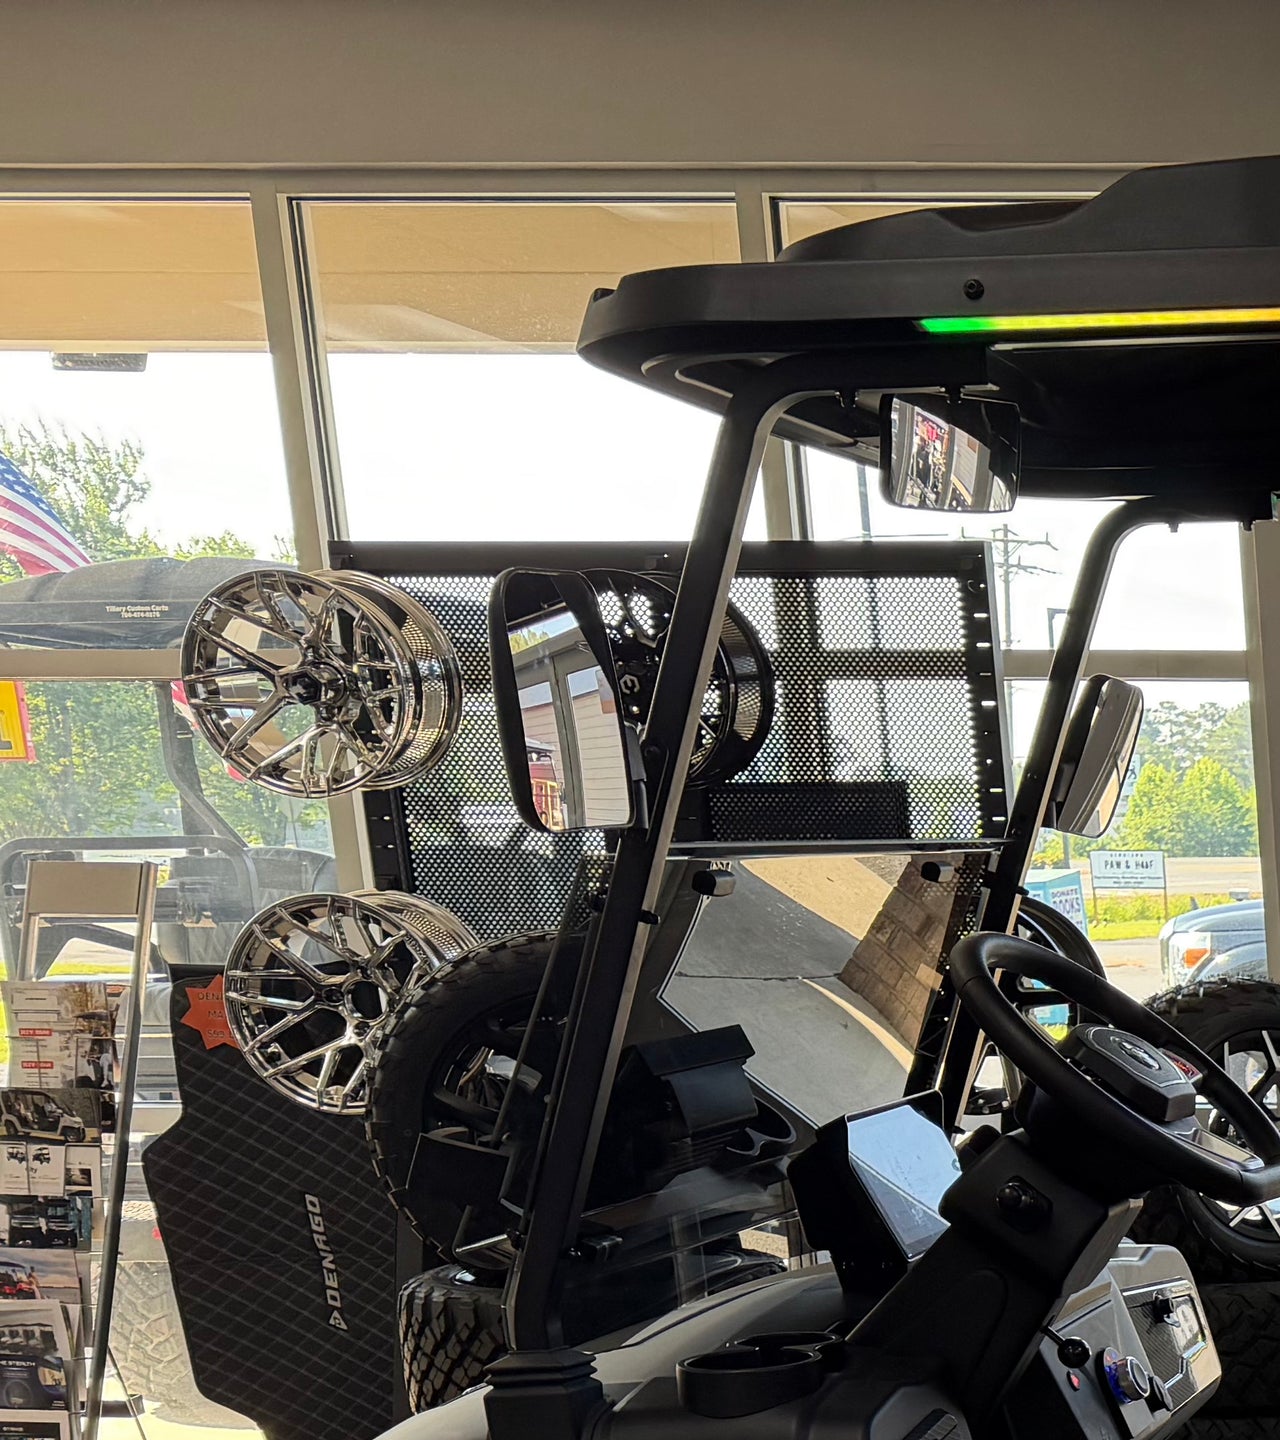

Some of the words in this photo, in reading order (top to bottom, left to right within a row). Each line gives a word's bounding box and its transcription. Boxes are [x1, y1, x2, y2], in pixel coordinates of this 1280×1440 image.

[1104, 860, 1121, 869] PAW
[1125, 860, 1131, 869] &
[1051, 888, 1078, 898] DONATE
[198, 992, 223, 1001] DEN
[208, 1010, 224, 1019] MA
[304, 1192, 342, 1309] DENAGO
